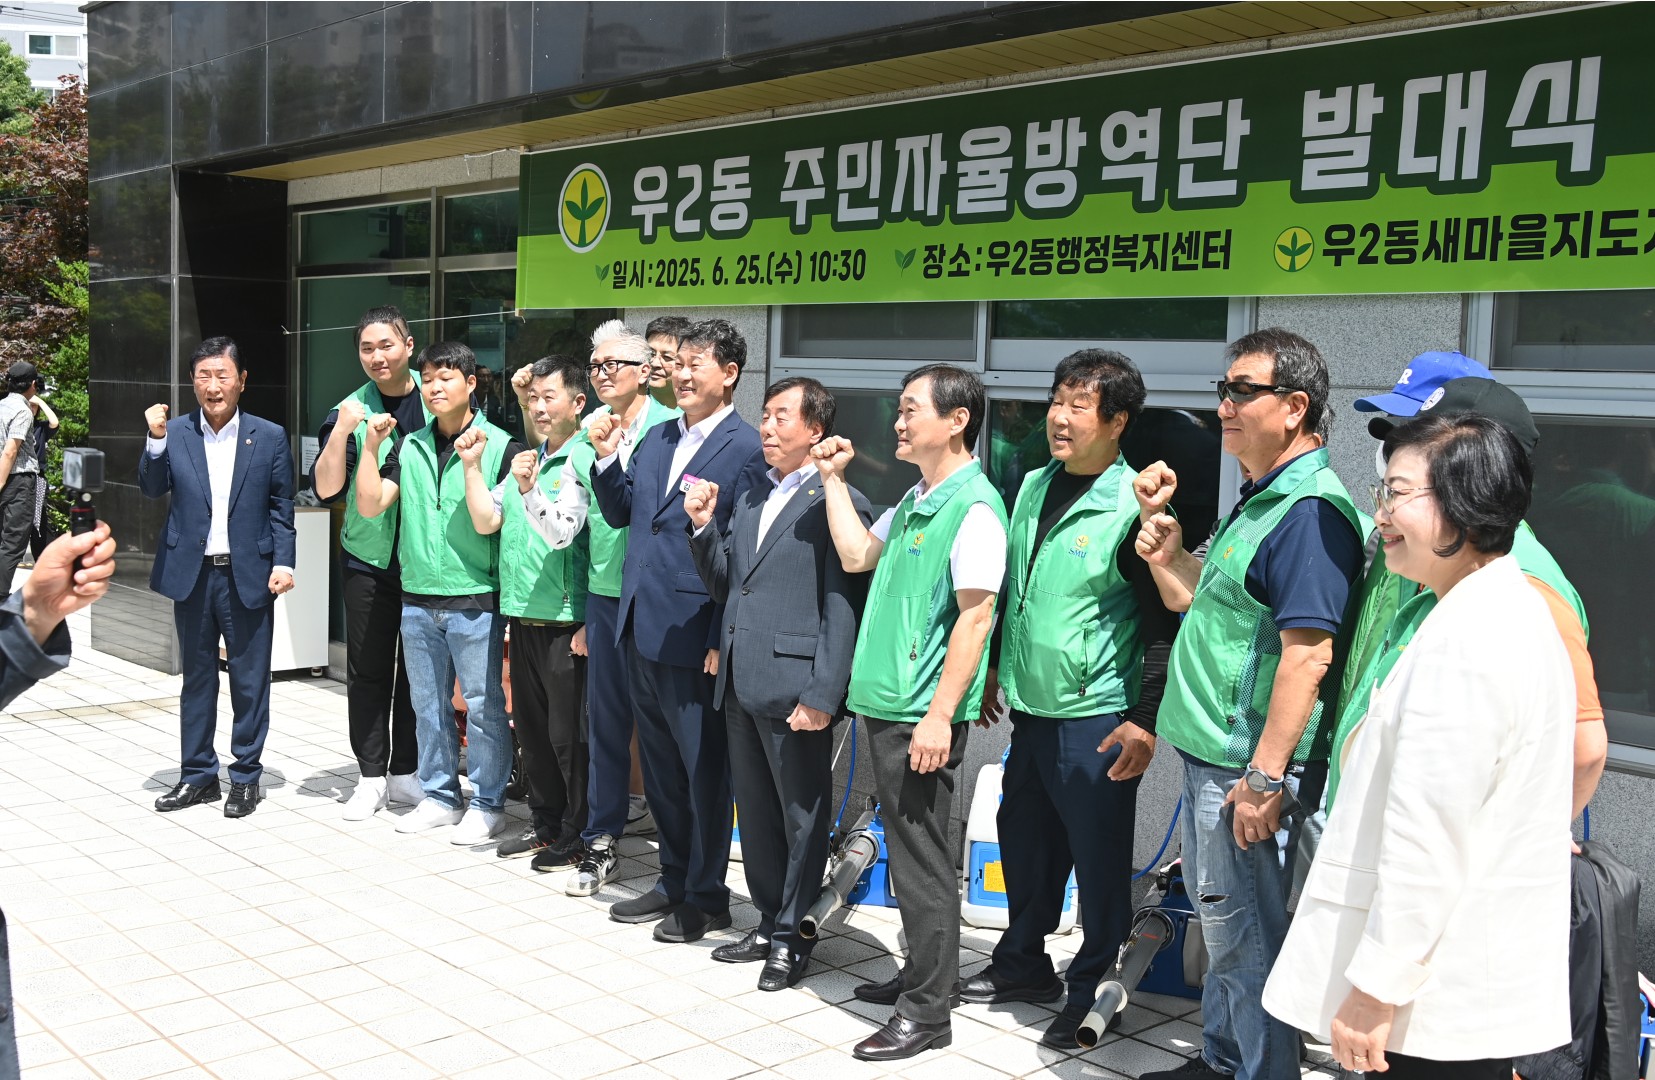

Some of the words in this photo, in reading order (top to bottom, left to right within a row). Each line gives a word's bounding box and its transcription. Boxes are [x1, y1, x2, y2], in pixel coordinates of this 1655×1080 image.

[630, 155, 751, 236] 우2동
[780, 97, 1251, 226] 주민자율방역단
[1301, 56, 1601, 191] 발대식
[612, 256, 705, 289] 일시:2025.
[712, 259, 729, 286] 6.
[735, 252, 802, 286] 25.(수)
[809, 248, 866, 281] 10:30
[922, 229, 1233, 279] 장소:우2동행정복지센터
[1397, 368, 1413, 385] R
